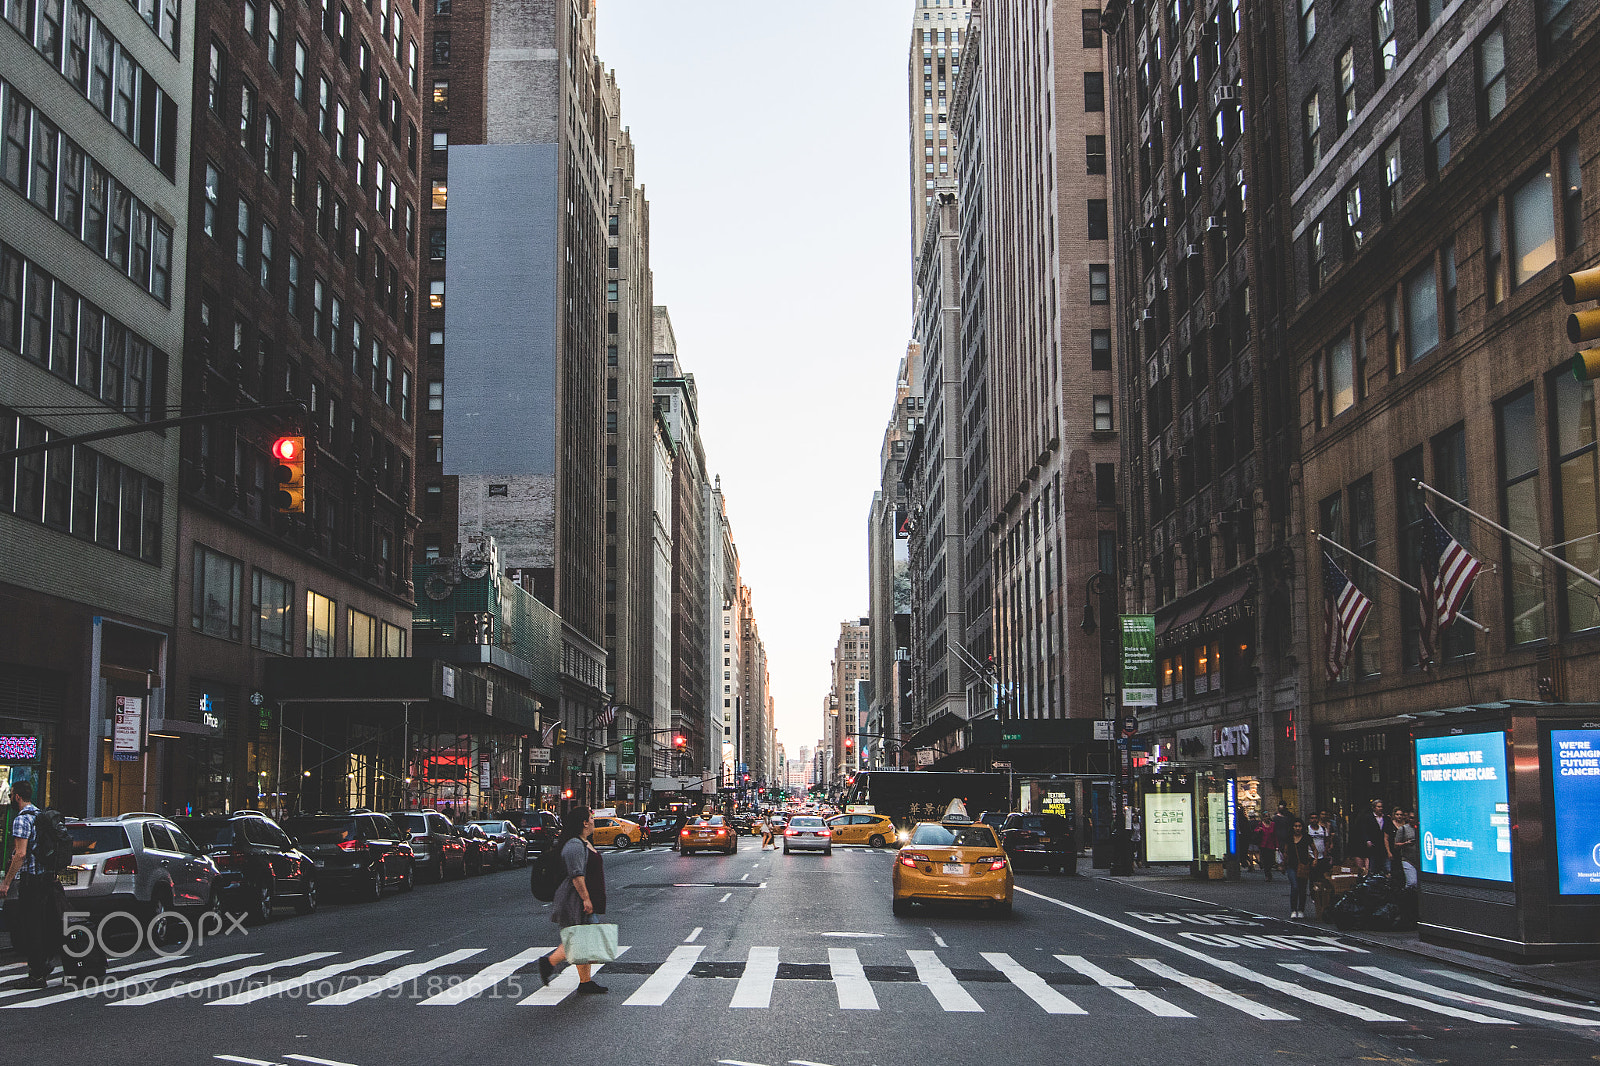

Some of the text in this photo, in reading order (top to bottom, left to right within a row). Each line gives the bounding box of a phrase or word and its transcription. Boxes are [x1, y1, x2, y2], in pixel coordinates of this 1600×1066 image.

[199, 693, 213, 712] dEx
[203, 712, 219, 728] Office
[1221, 723, 1250, 757] GIFTS
[1558, 741, 1591, 750] WE'RE
[1420, 750, 1483, 766] WE'RE CHANGING THE
[1559, 750, 1600, 758] CHANGIN
[1560, 759, 1599, 767] FUTURE
[1420, 769, 1443, 782] FUTURE
[1442, 769, 1453, 781] OF
[1452, 768, 1478, 781] CANCER
[1124, 911, 1264, 927] BUS
[1177, 931, 1371, 954] ONLY
